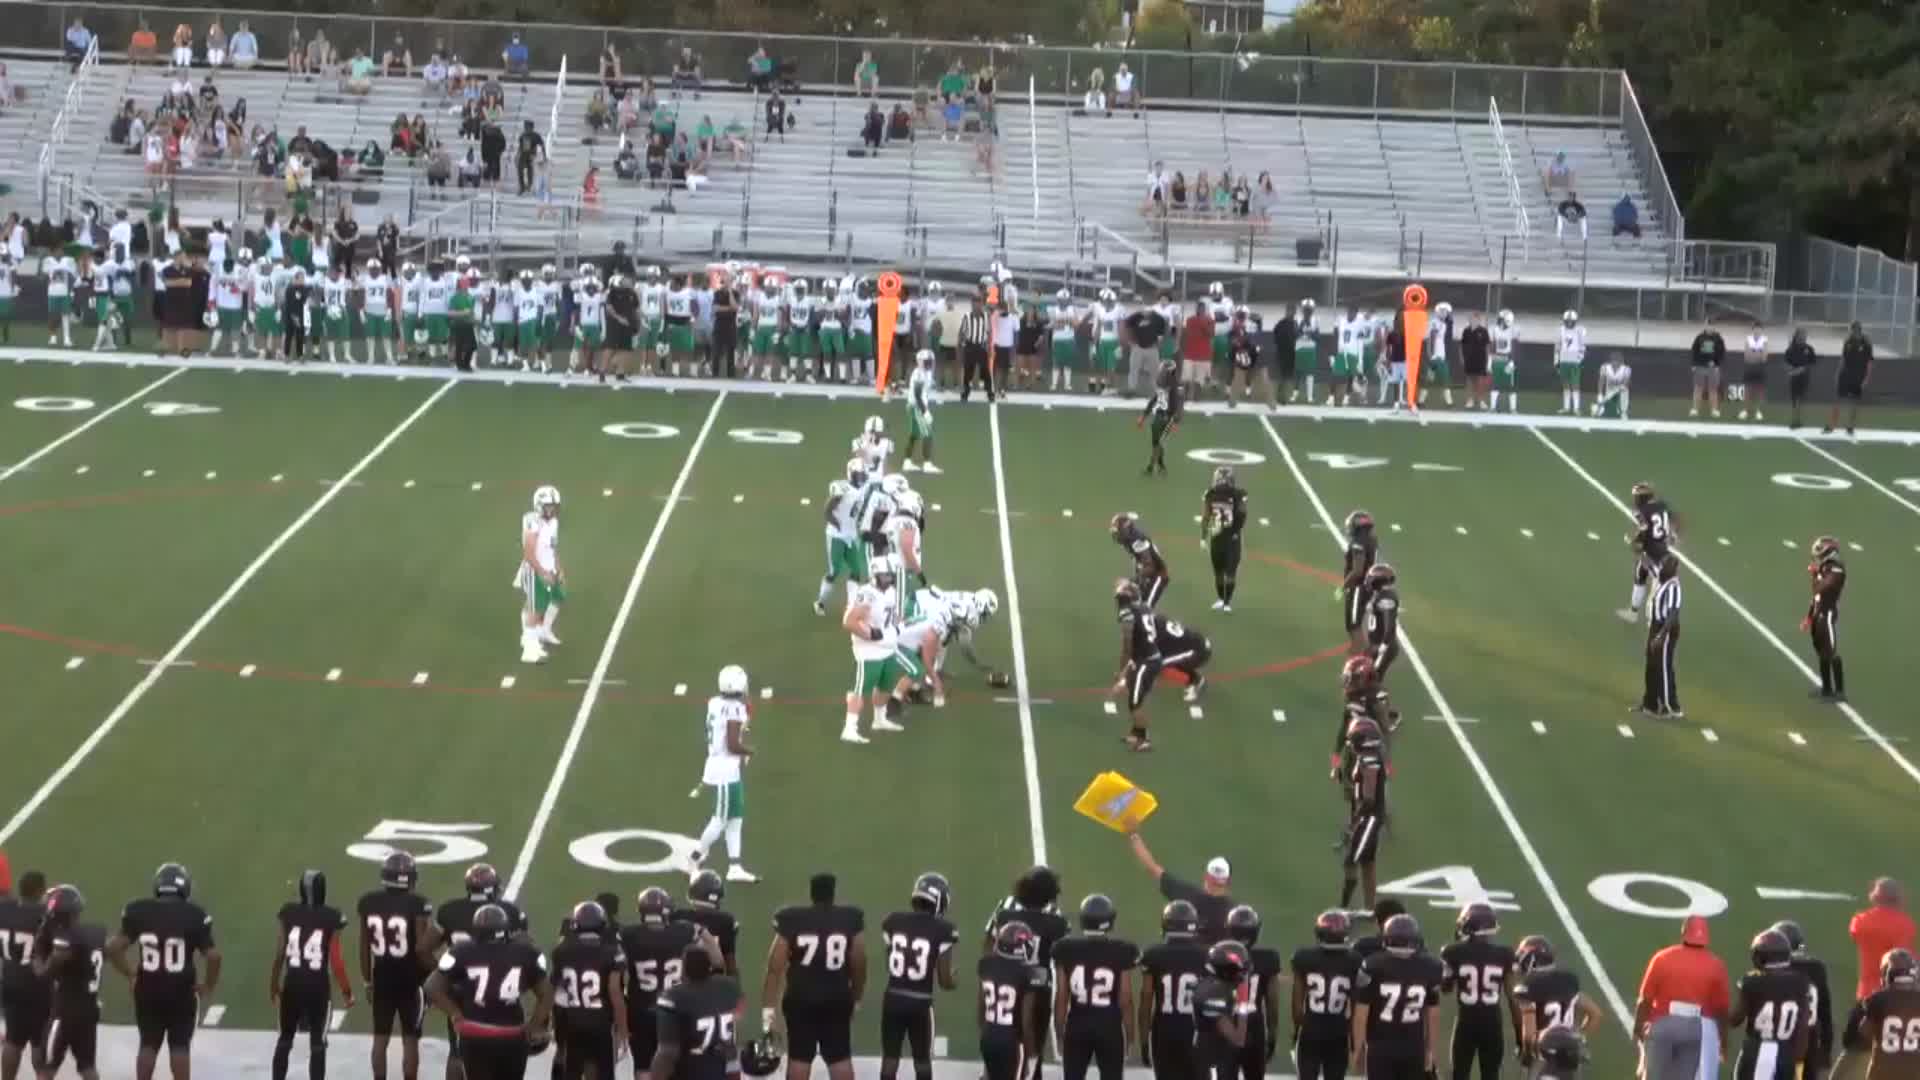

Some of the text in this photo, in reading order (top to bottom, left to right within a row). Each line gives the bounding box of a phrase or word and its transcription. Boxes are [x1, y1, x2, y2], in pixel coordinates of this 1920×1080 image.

[139, 933, 186, 973] 60
[286, 927, 324, 970] 44
[368, 916, 408, 957] 33
[797, 934, 847, 971] 78
[635, 958, 684, 992] 52
[888, 934, 930, 981] 63
[467, 967, 522, 1006] 74
[982, 980, 1017, 1025] 22
[1070, 965, 1114, 1006] 42
[1307, 973, 1350, 1014] 26
[1379, 983, 1426, 1023] 72
[1459, 965, 1503, 1005] 35
[1754, 1001, 1799, 1040] 40
